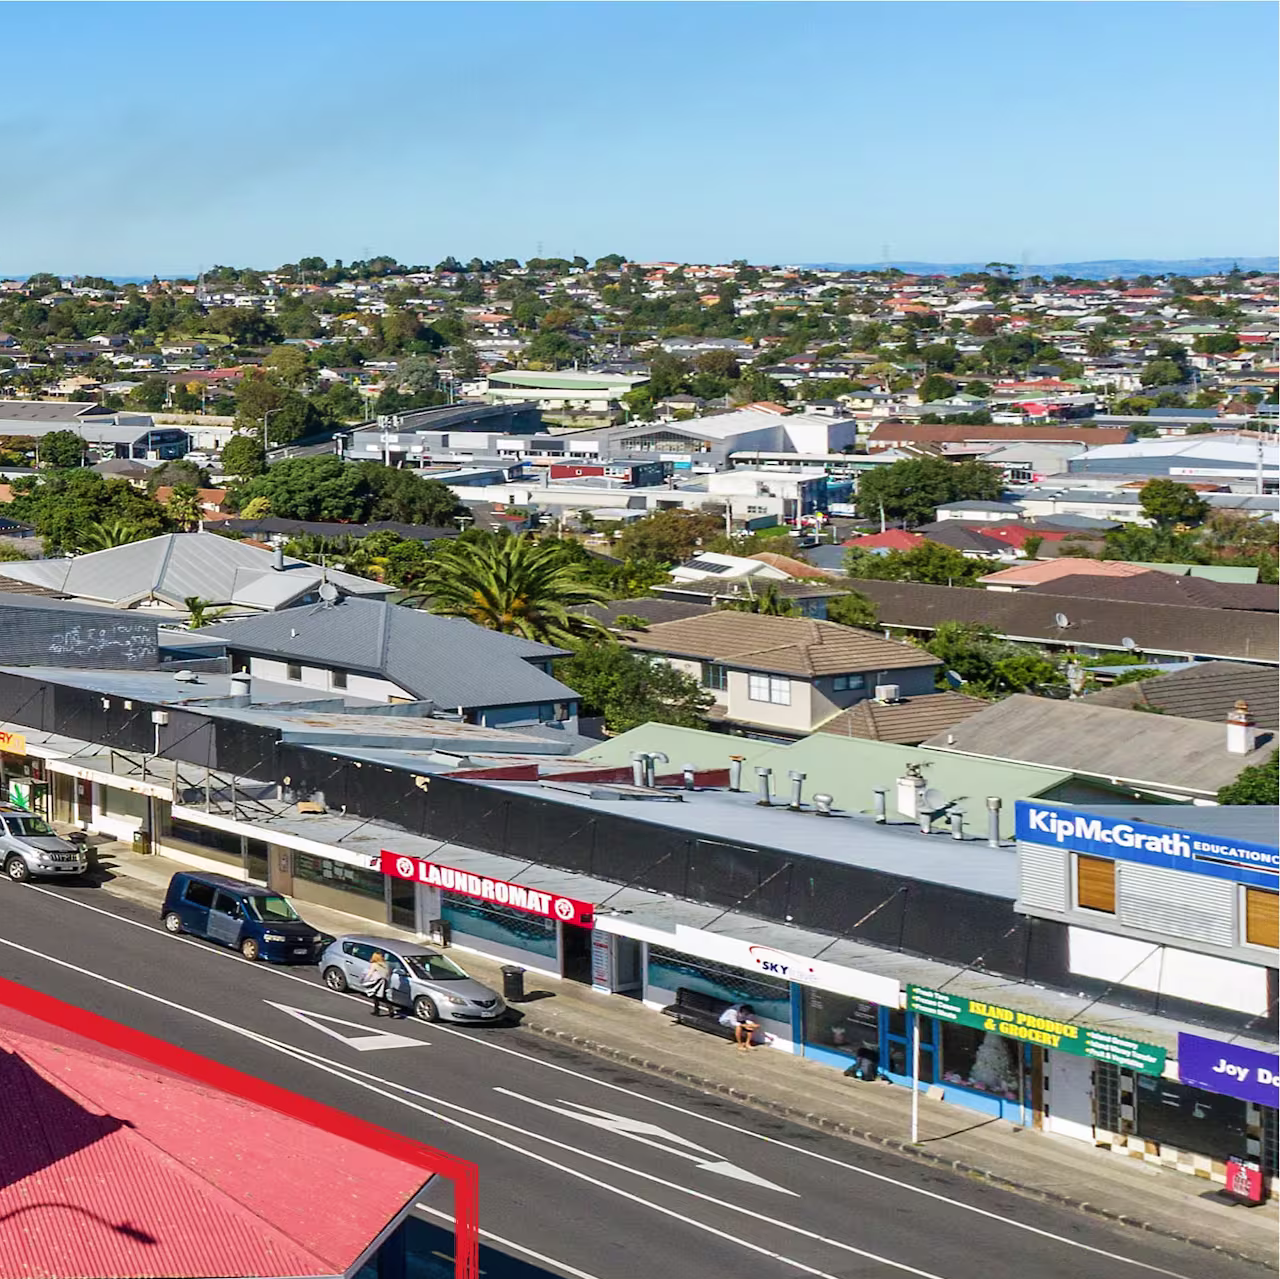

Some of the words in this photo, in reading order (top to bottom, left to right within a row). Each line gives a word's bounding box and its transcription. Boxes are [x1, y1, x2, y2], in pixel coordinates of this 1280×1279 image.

[1029, 808, 1191, 858] KipMcGrath
[418, 861, 552, 915] LAUNDROMAT
[762, 961, 789, 975] SKY
[969, 1000, 1014, 1022] ISLAND
[1016, 1012, 1078, 1039] PRODUCE
[984, 1018, 996, 1031] &
[999, 1021, 1061, 1048] GROCERY
[1212, 1059, 1250, 1081] Joy
